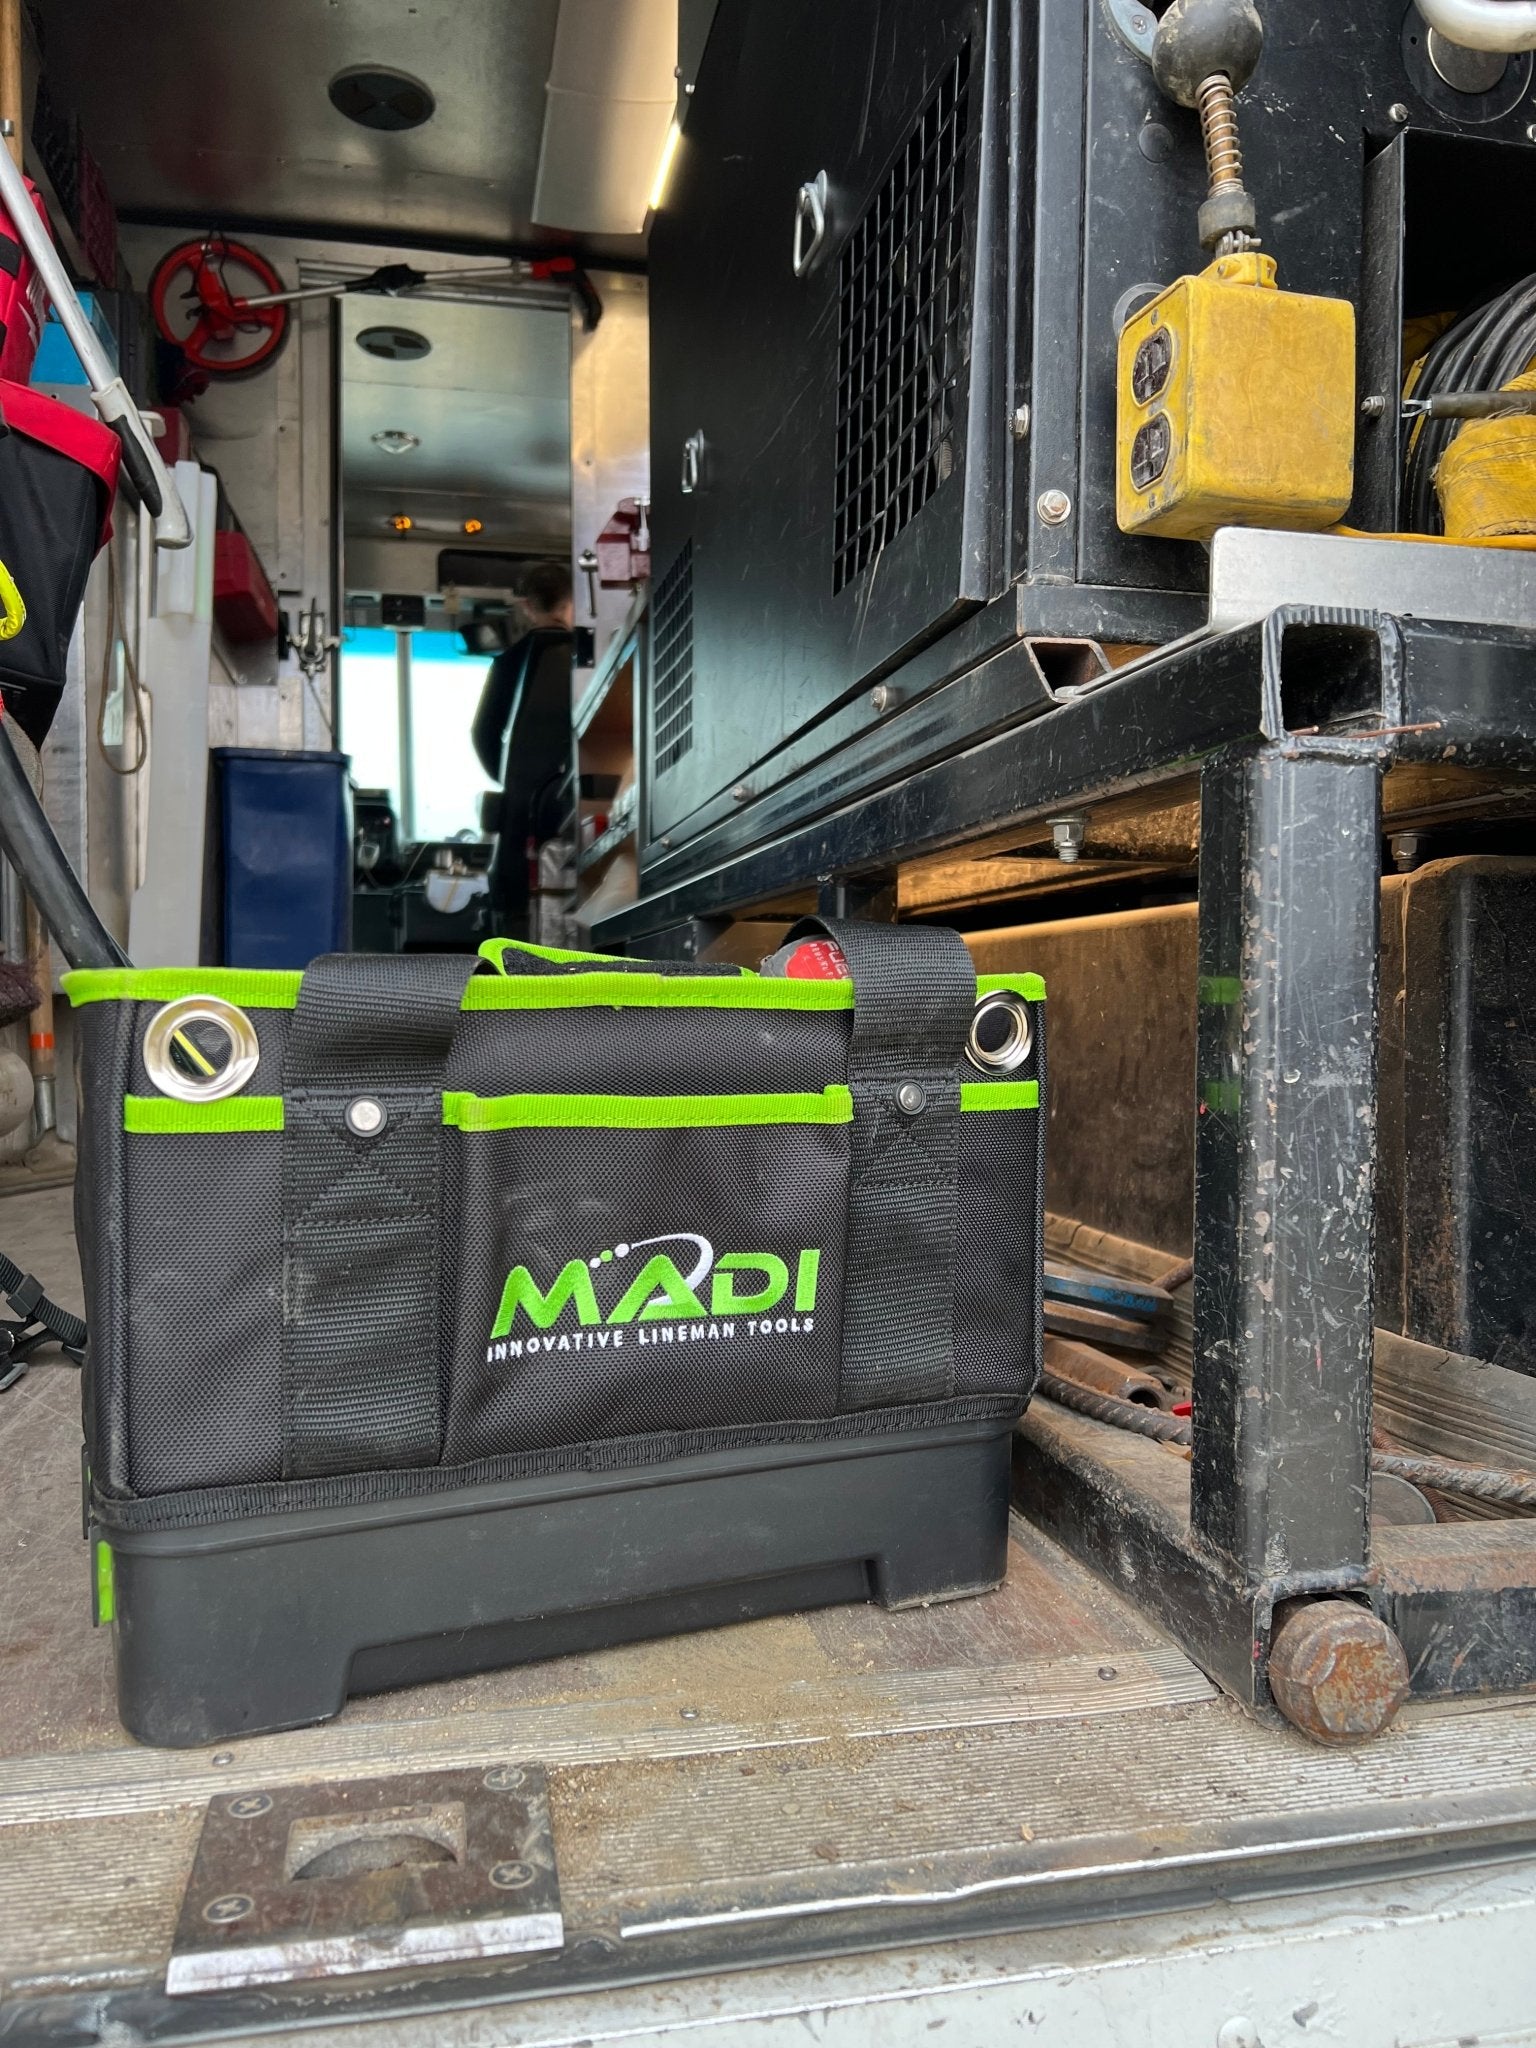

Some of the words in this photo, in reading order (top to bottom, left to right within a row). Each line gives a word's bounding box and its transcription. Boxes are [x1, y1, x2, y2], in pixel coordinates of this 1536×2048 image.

[823, 940, 850, 979] FUE
[490, 1249, 821, 1339] MADI
[486, 1330, 624, 1362] INNOVATIVE
[638, 1322, 735, 1346] LINEMAN
[747, 1317, 814, 1336] TOOLS
